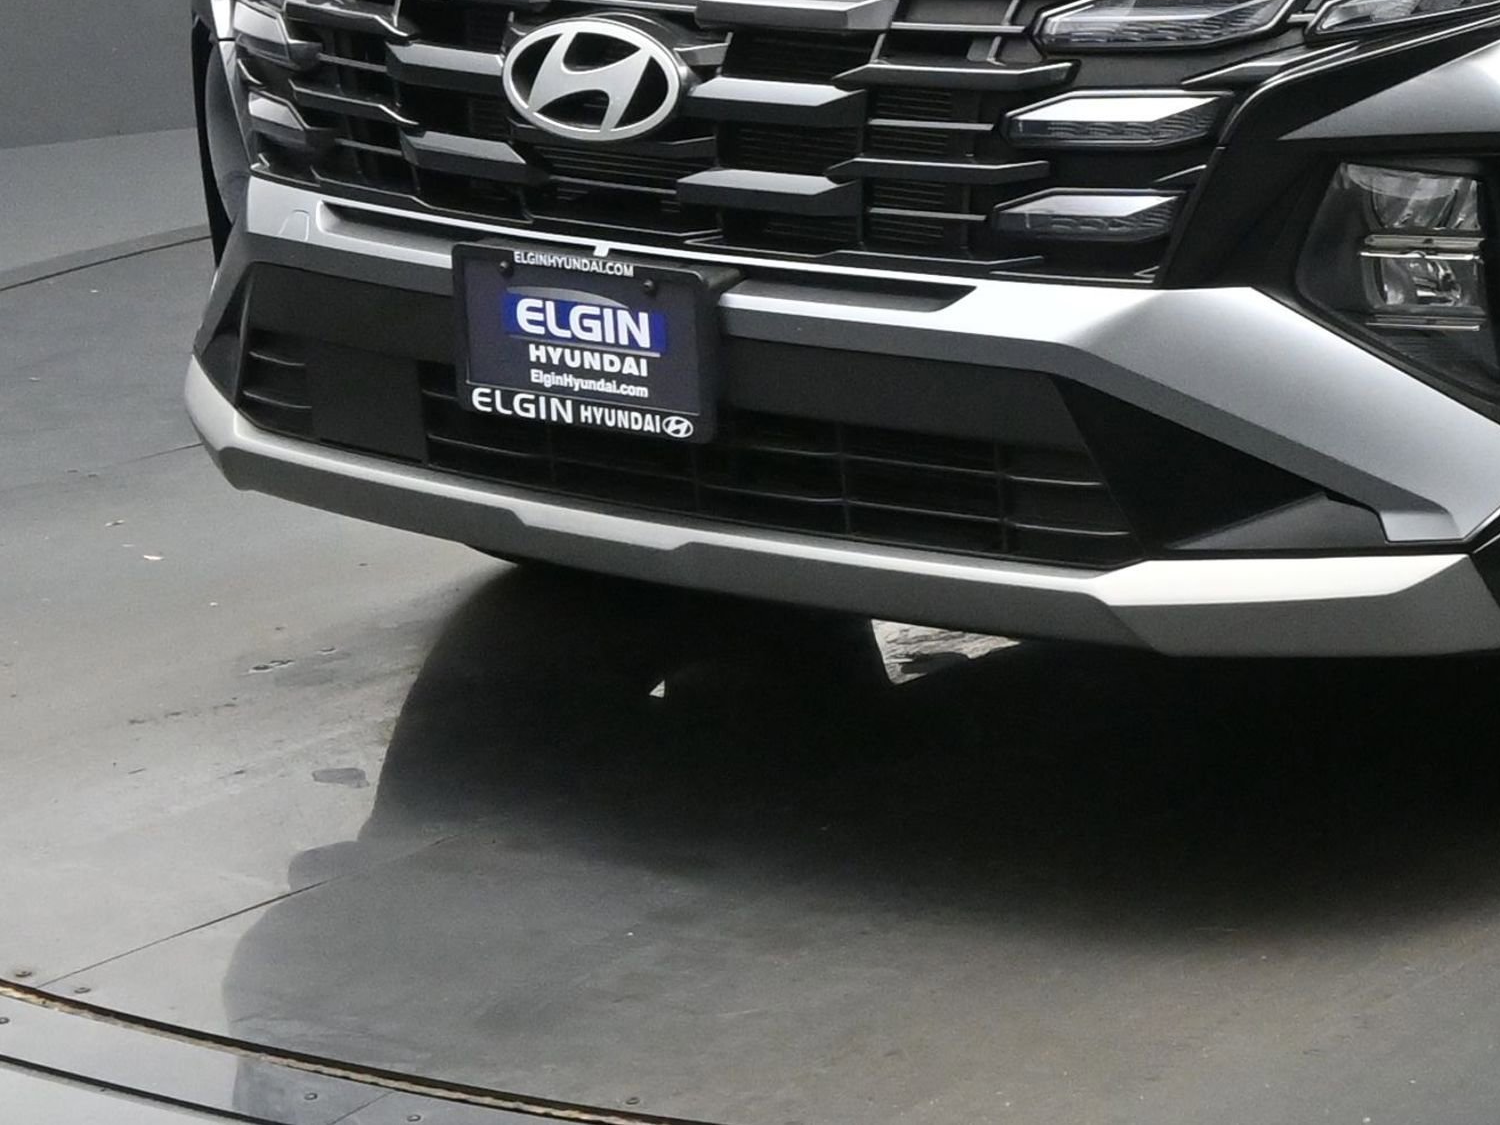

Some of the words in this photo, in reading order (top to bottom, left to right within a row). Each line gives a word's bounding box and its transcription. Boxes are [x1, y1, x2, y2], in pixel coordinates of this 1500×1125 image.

[513, 251, 634, 277] ELGINHYUNDAI.COM
[516, 298, 650, 348] ELGIN
[528, 343, 648, 377] HYUNDAI
[530, 369, 649, 398] ElginHyundai.com
[471, 387, 573, 424] ELGIN
[580, 404, 661, 433] HYUNDAI
